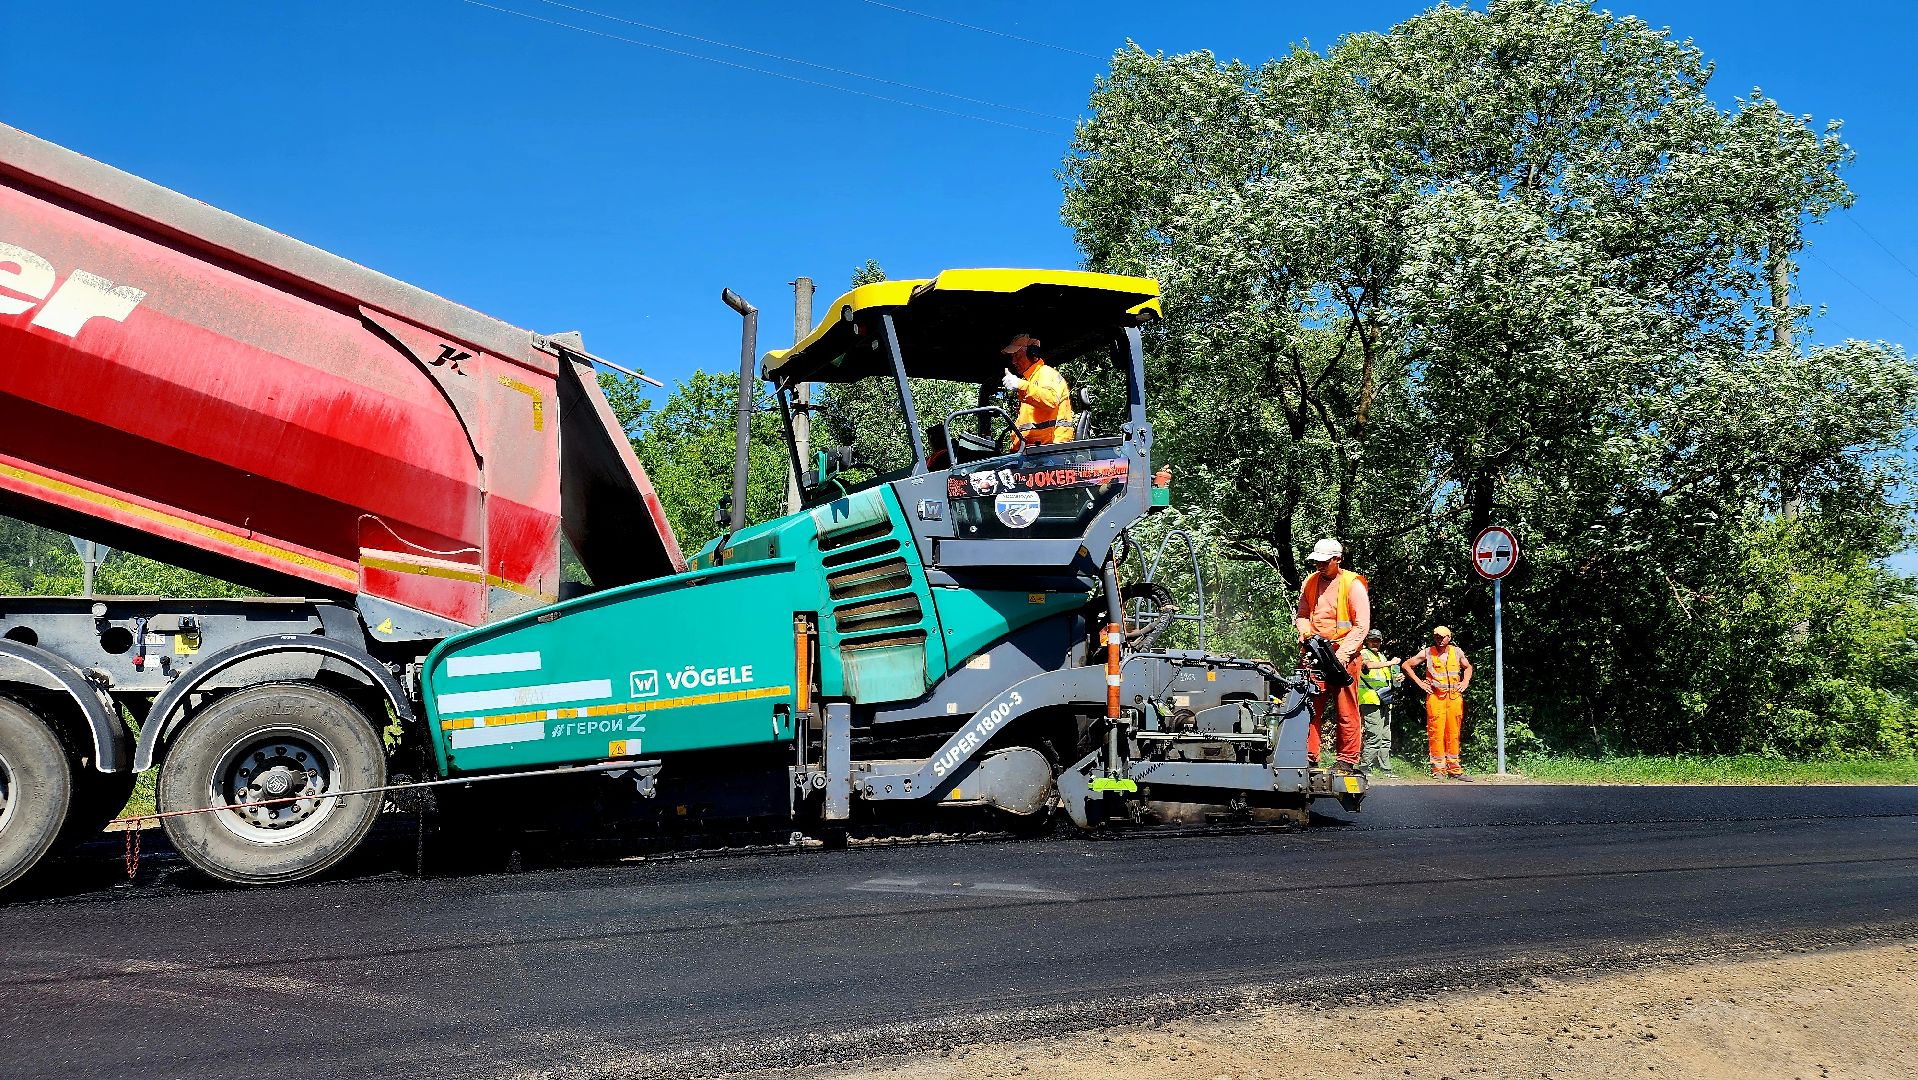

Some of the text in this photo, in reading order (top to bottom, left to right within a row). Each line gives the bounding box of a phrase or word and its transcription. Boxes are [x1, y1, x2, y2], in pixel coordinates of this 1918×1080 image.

[0, 242, 147, 338] er
[1026, 469, 1076, 489] JOKER
[666, 665, 754, 690] VÖGELE
[551, 714, 647, 738] #ГЕРОИ Z
[933, 691, 1023, 777] SUPER 1800-3
